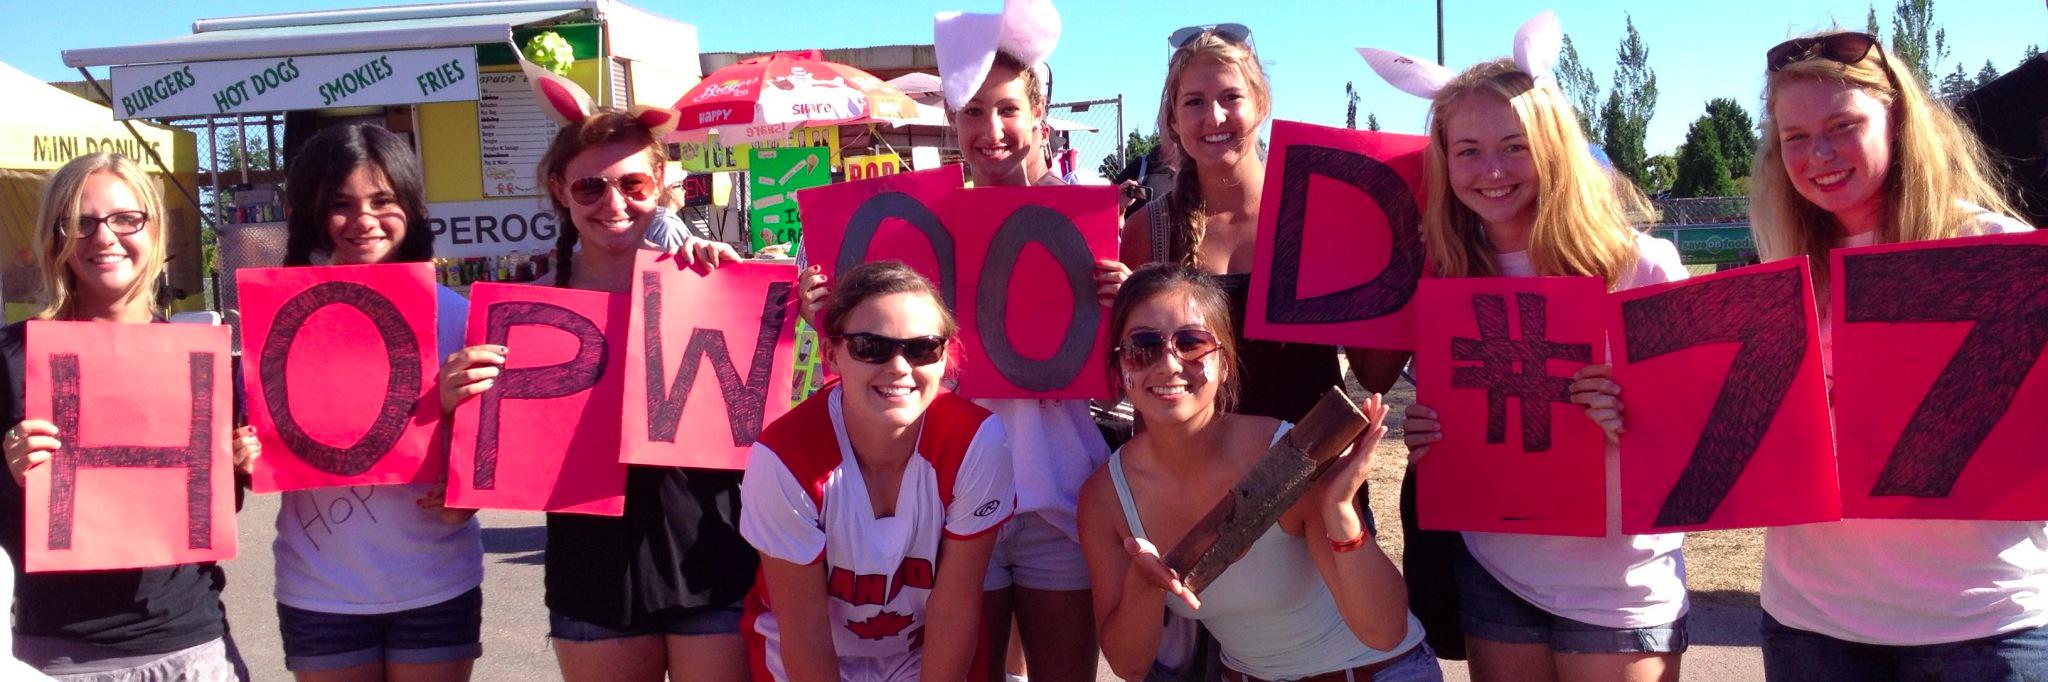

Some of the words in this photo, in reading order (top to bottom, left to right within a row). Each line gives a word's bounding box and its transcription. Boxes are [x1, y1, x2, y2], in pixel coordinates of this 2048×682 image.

[121, 65, 196, 116] BURGERS
[212, 80, 250, 113] HOT
[250, 58, 300, 96] DOGS
[318, 55, 394, 106] SMOKIES
[416, 59, 465, 97] FRIES
[33, 134, 79, 162] MINI
